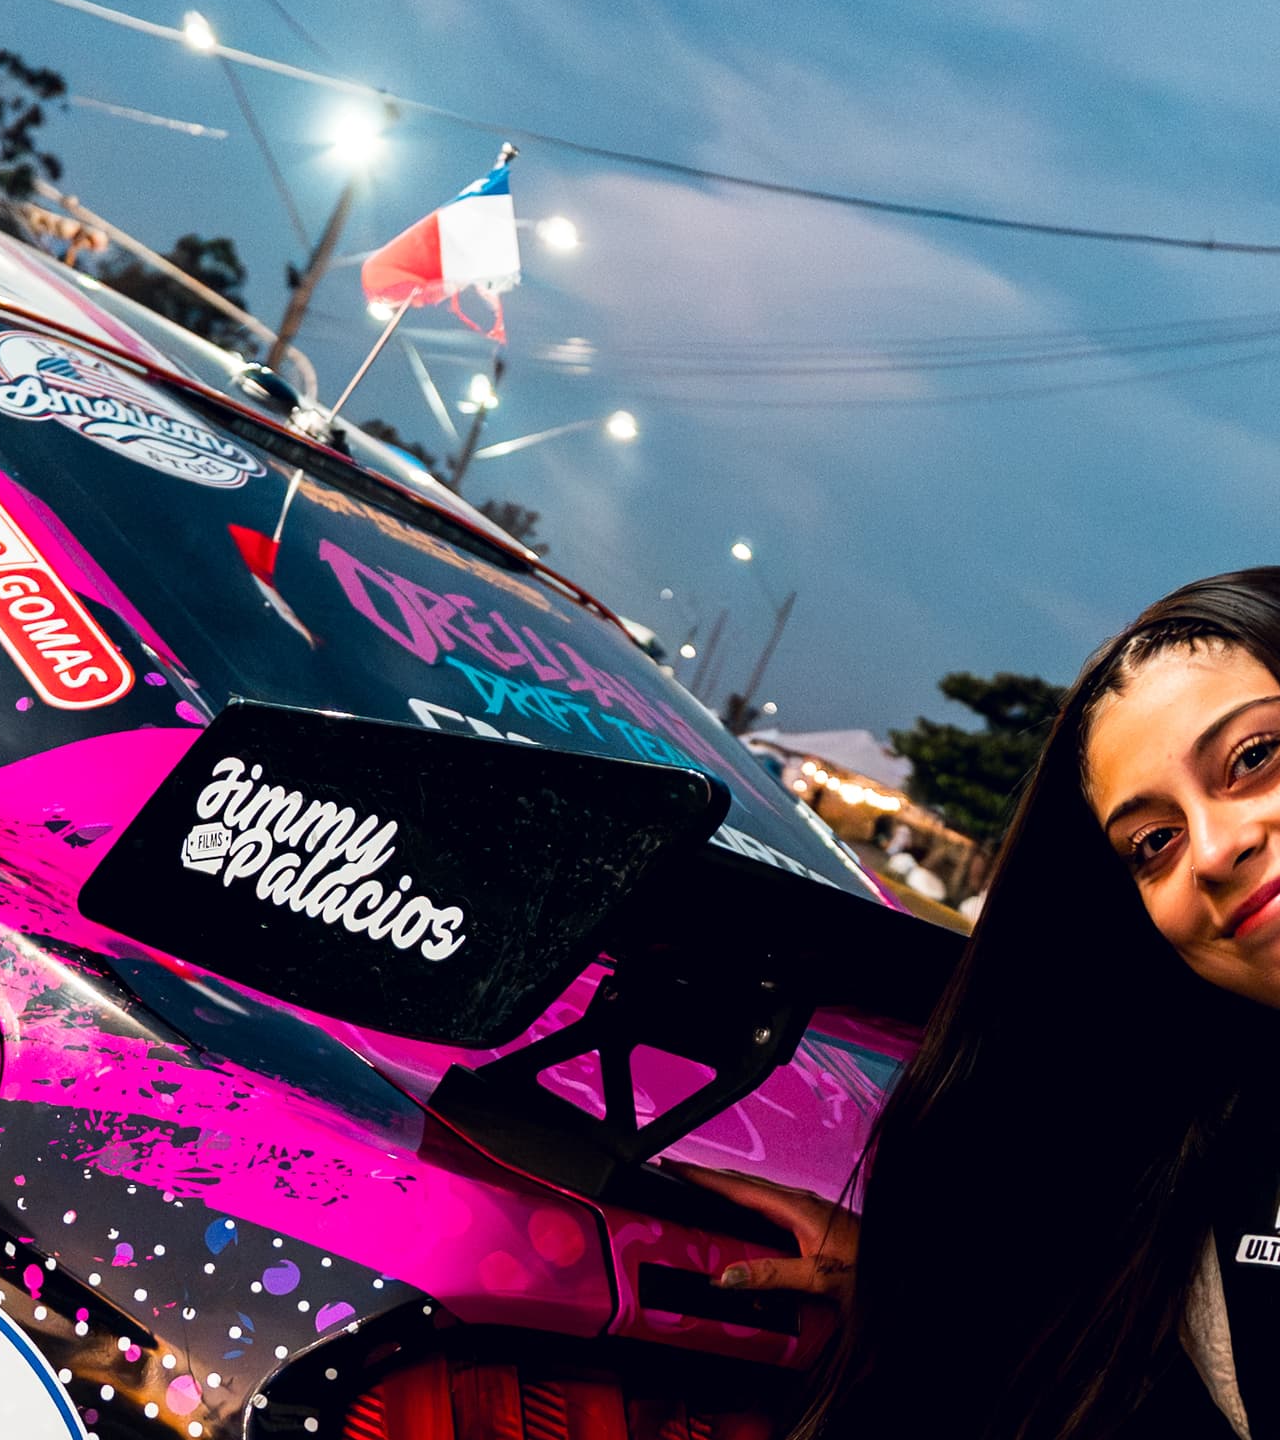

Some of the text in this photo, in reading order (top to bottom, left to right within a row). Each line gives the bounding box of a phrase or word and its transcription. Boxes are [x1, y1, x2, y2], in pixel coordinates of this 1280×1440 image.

[446, 656, 606, 743] DRIFT
[196, 757, 398, 885] Jimmy
[197, 832, 223, 849] FILMS
[224, 827, 466, 961] Palacios
